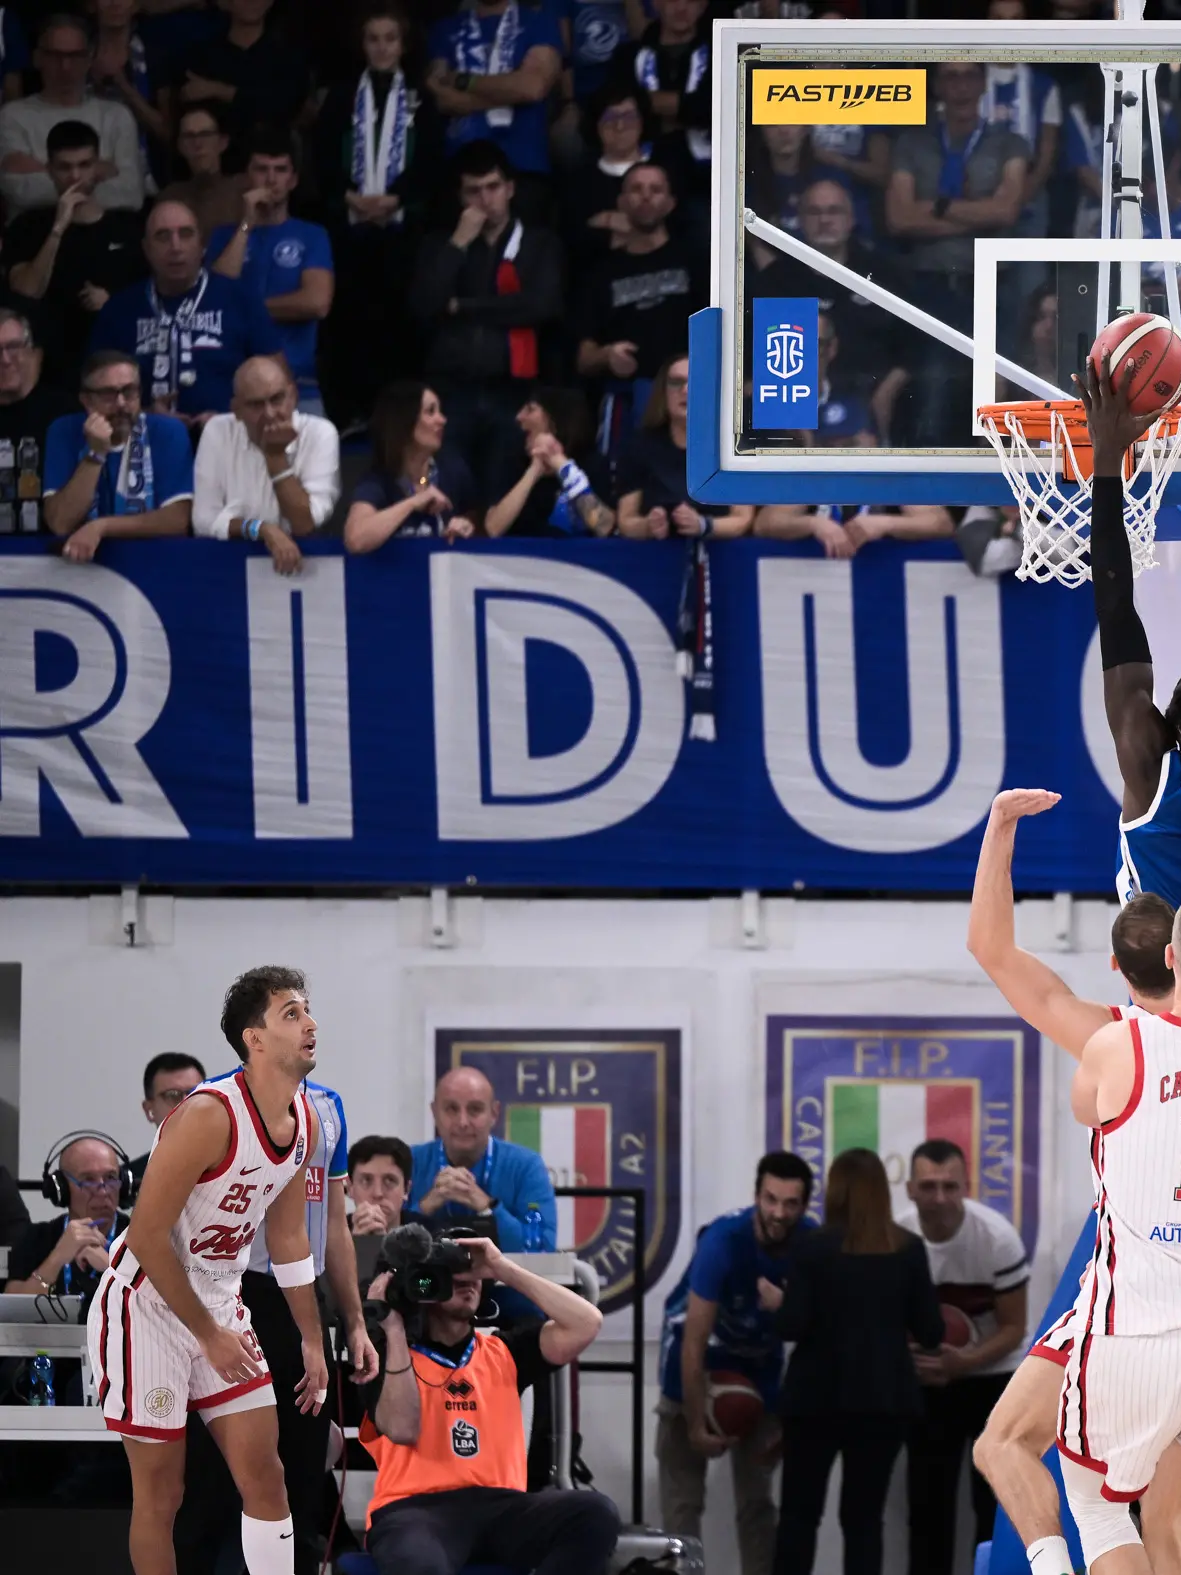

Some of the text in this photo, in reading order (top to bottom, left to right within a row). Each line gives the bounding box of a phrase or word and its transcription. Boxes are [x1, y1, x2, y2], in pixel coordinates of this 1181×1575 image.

[766, 84, 912, 109] FASTWEB
[759, 384, 812, 403] FIP
[516, 1058, 600, 1097] F.I.P.
[217, 1182, 258, 1215] 25
[454, 1439, 476, 1449] LBA
